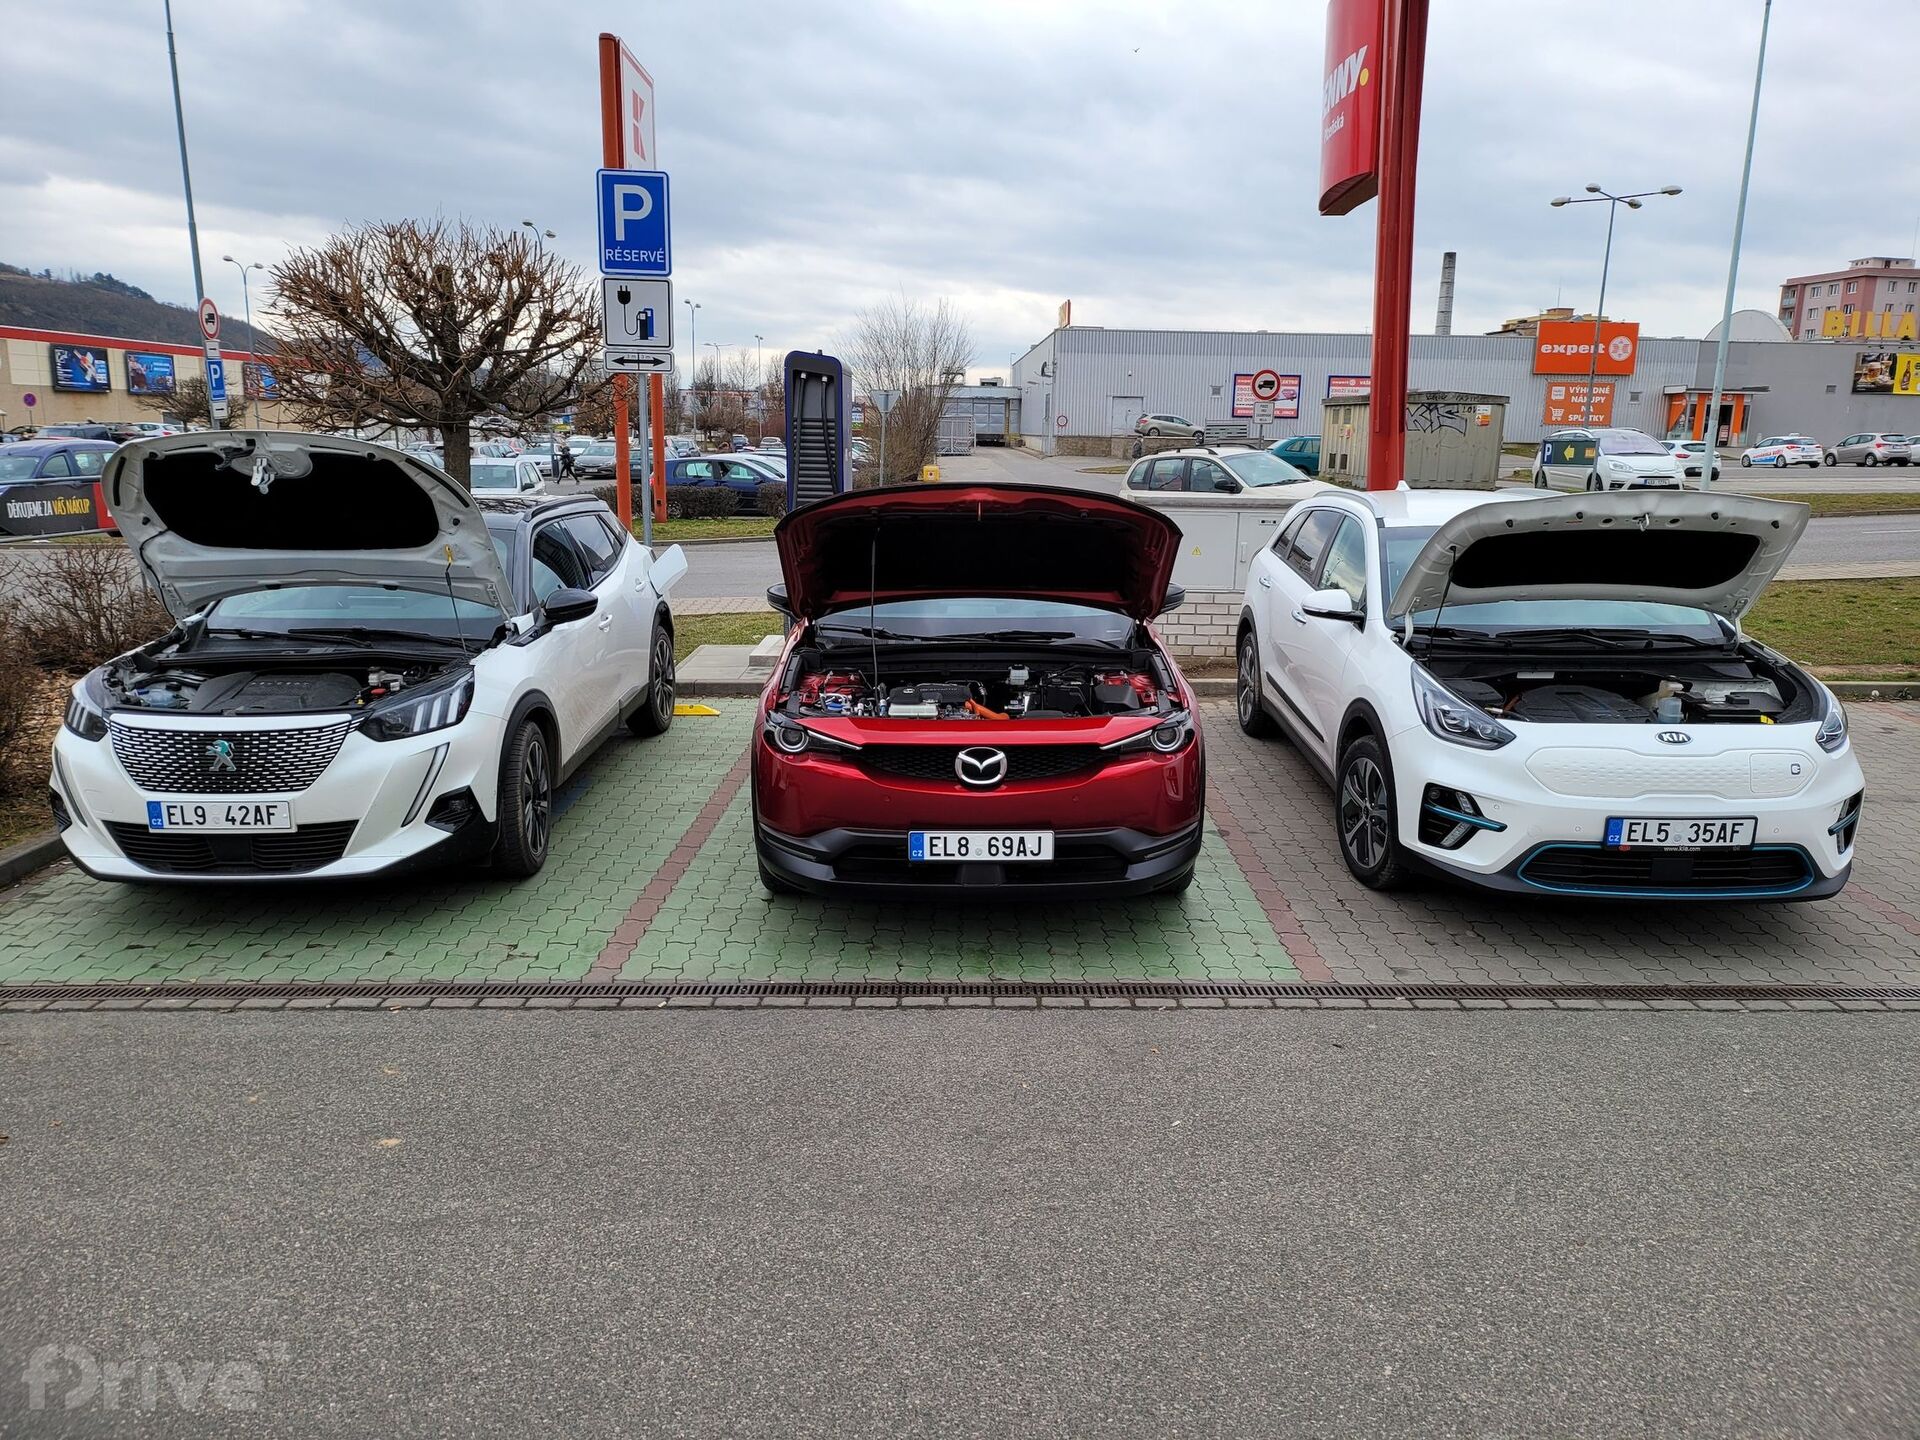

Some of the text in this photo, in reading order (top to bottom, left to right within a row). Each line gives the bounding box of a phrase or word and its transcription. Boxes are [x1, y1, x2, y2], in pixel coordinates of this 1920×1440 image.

[614, 183, 653, 242] P
[605, 245, 665, 264] RÉSERVÉ
[1822, 309, 1917, 338] BILLA
[209, 364, 221, 388] P
[1544, 443, 1552, 462] P
[6, 499, 43, 519] DĚKUJEME
[42, 500, 54, 517] ZA
[66, 495, 90, 515] NÁKUP
[1662, 732, 1689, 743] KIA
[151, 805, 278, 826] CZ EL9 42AF
[1608, 822, 1744, 843] CZ EL5 35AF
[929, 836, 970, 857] EL8
[987, 836, 1042, 857] 69AJ
[1663, 844, 1701, 852] www.kia.com
